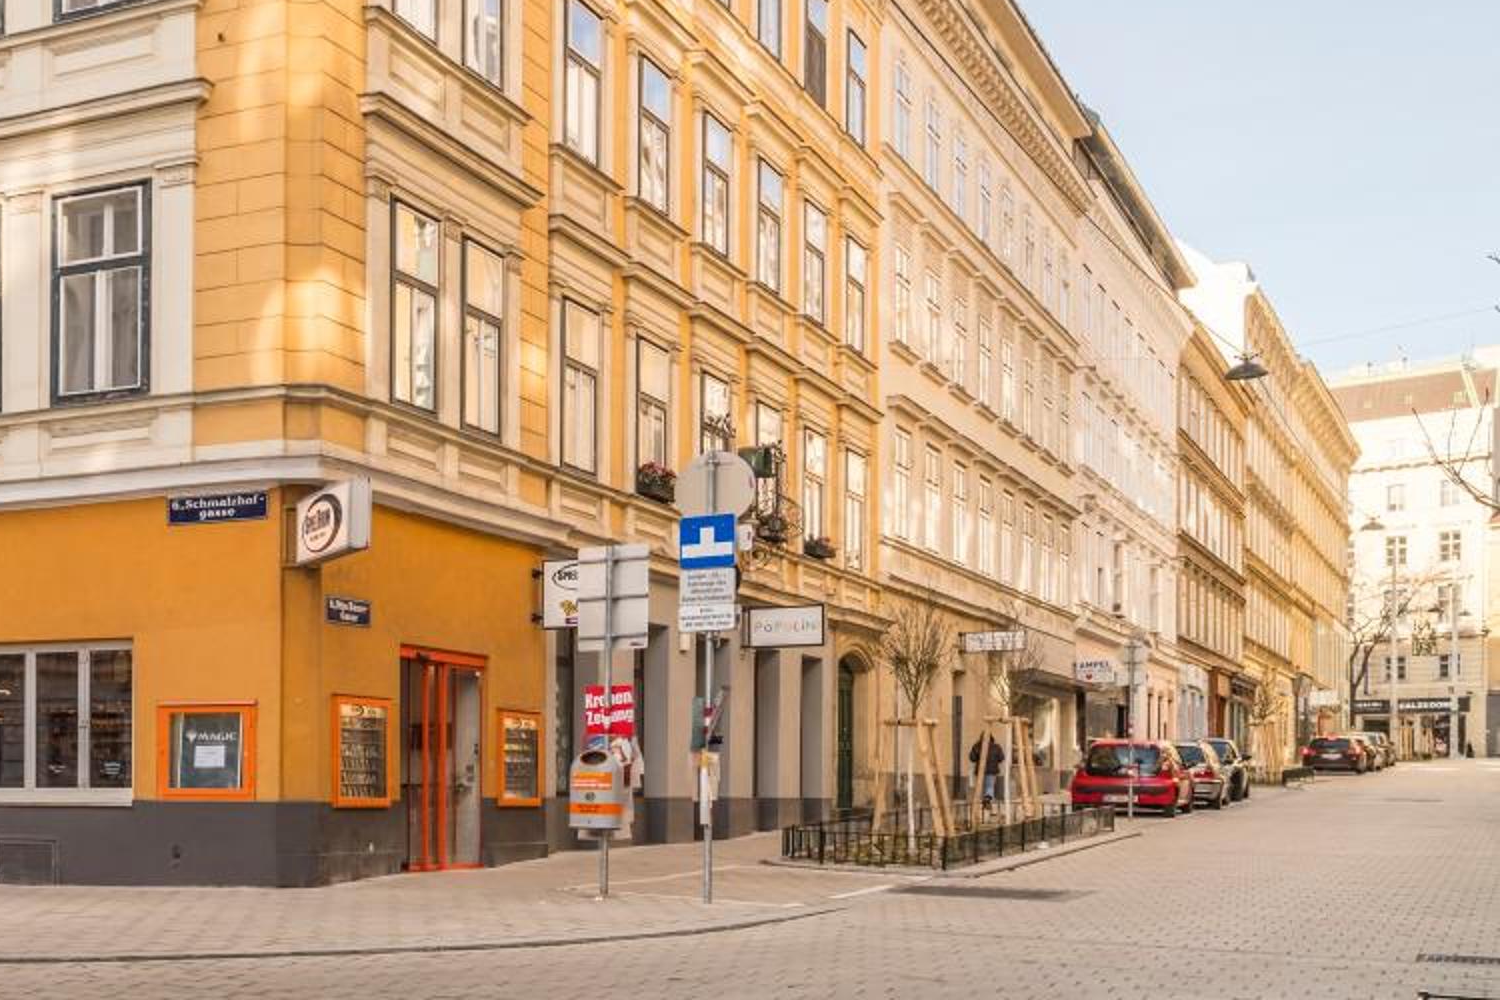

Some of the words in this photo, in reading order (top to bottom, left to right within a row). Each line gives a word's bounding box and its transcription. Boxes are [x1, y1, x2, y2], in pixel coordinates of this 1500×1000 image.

[199, 507, 236, 520] gasse
[586, 709, 634, 726] Zeiung
[198, 731, 237, 741] MAGIC
